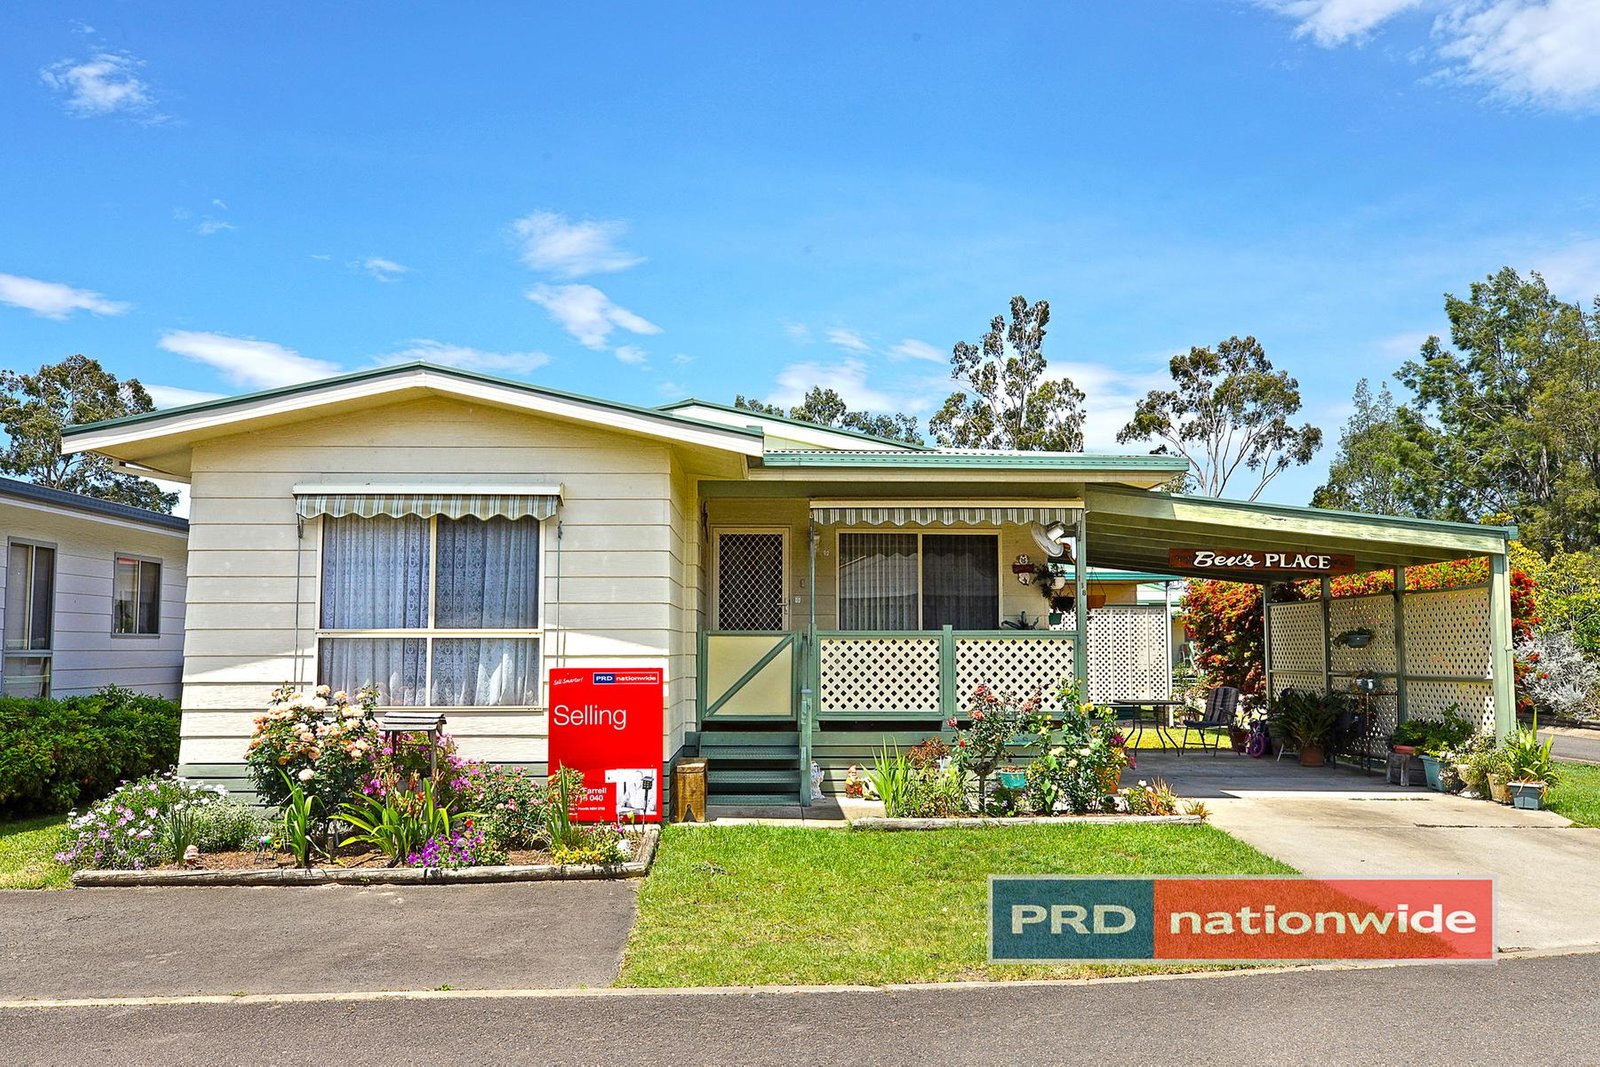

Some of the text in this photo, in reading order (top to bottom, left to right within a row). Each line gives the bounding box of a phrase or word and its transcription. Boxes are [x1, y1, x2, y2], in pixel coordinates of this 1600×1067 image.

[1193, 551, 1331, 569] Bev's PLACE
[553, 704, 626, 730] Selling
[589, 794, 604, 802] 040
